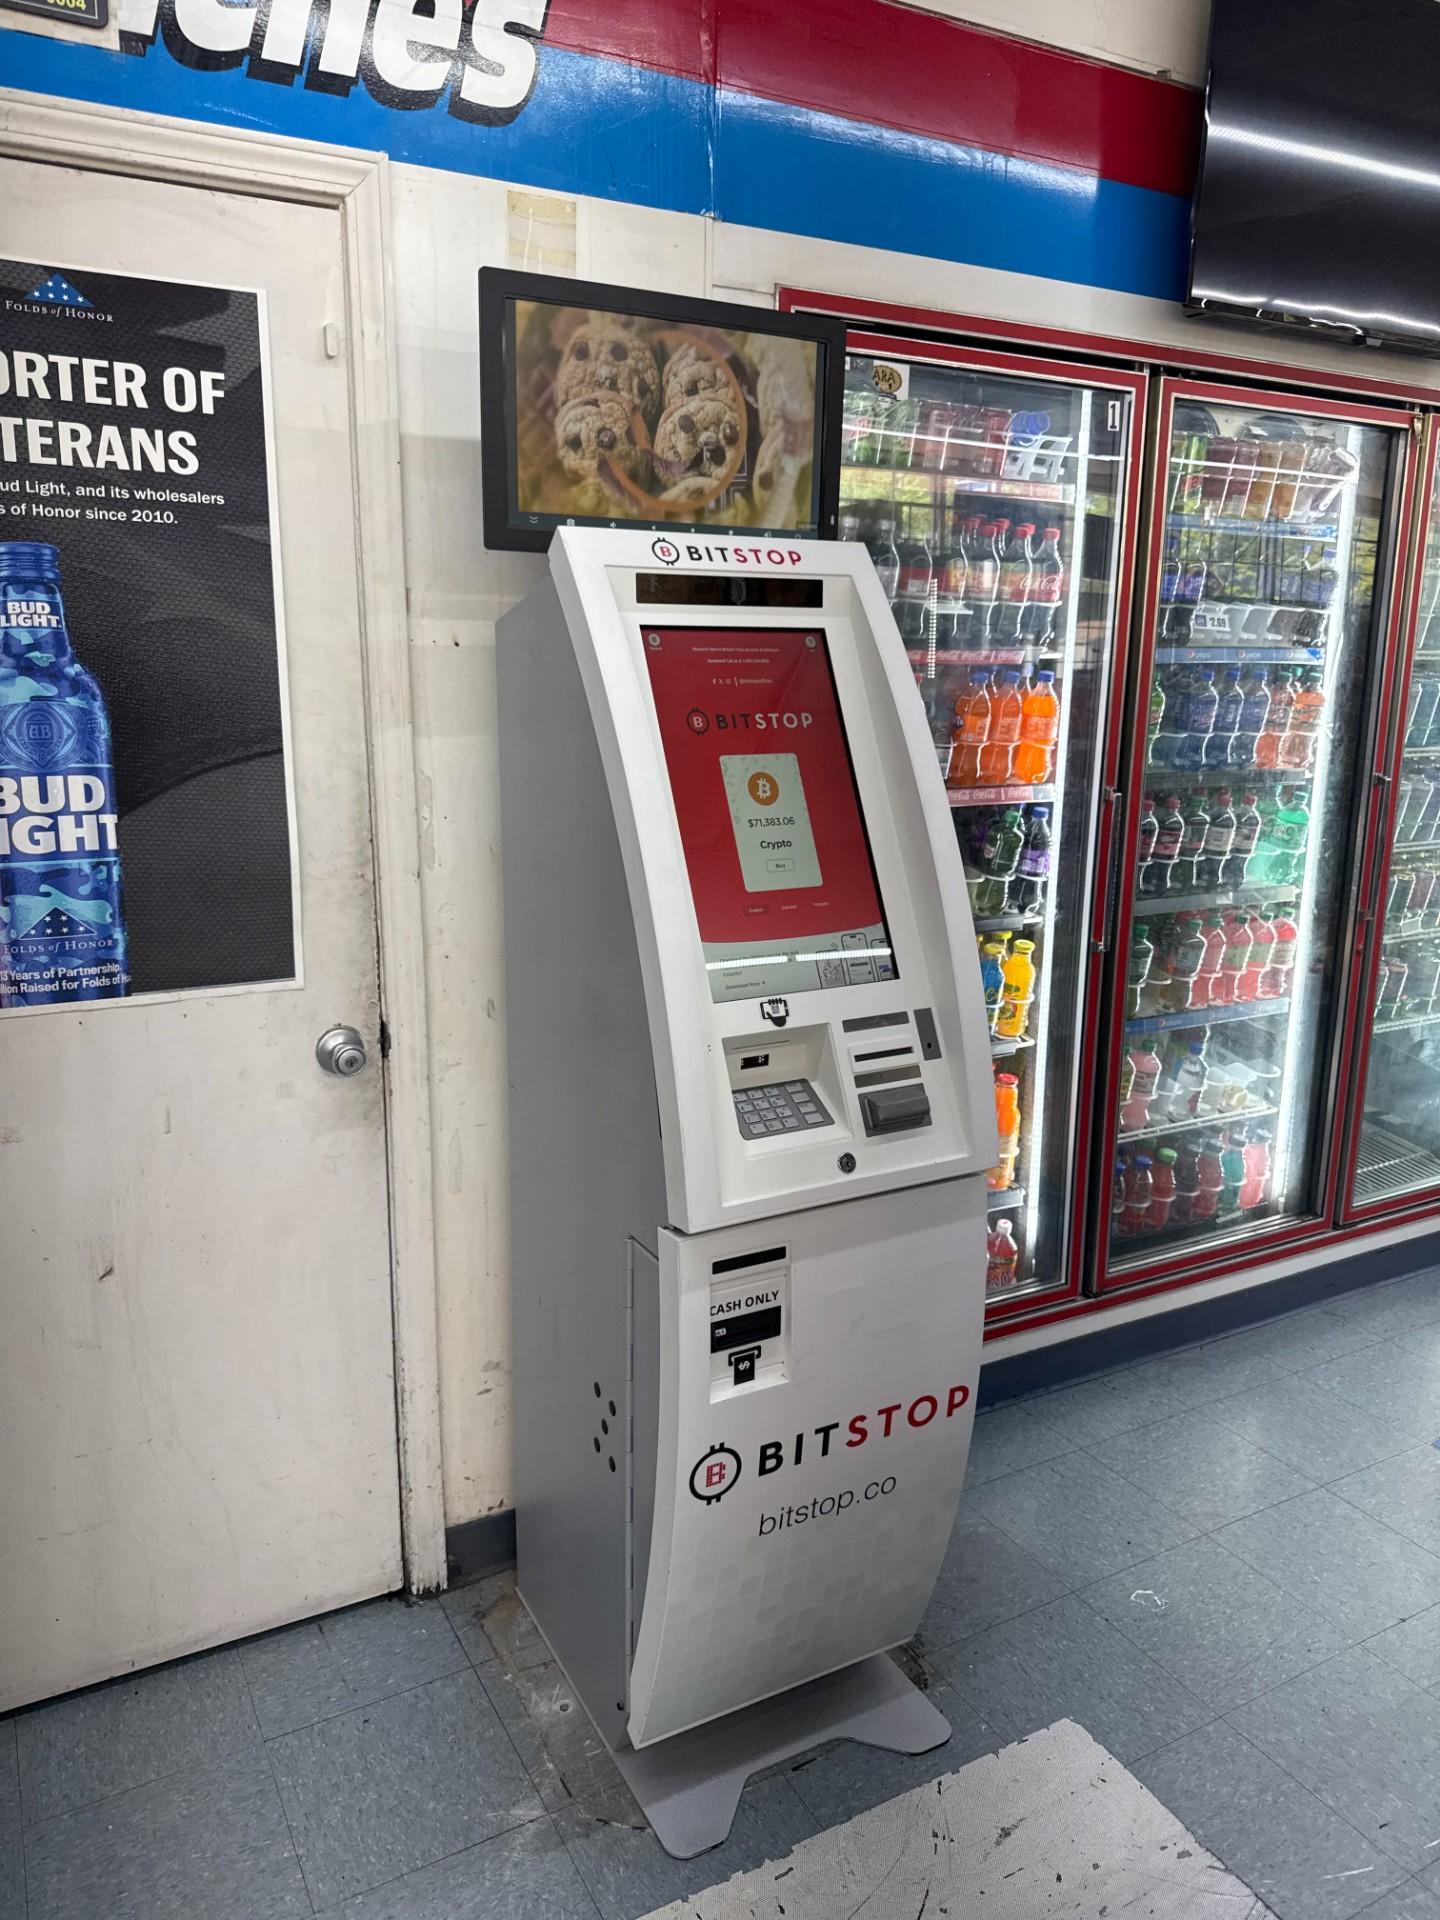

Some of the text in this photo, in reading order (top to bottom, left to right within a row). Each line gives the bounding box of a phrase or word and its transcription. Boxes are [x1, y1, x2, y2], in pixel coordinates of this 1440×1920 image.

[5, 300, 114, 323] FOLDS of HONOR
[162, 366, 226, 415] OF
[0, 416, 200, 476] TERANS
[25, 480, 71, 496] Light,
[75, 485, 106, 498] and
[110, 486, 130, 499] its
[134, 488, 225, 505] wholesalers
[10, 503, 27, 516] of
[32, 504, 81, 519] Honor
[85, 507, 127, 521] since
[131, 509, 178, 525] 2010.
[686, 545, 802, 566] BITSTOP
[7, 601, 51, 615] BUD
[716, 712, 813, 730] BITSTOP
[760, 840, 792, 850] Crypto
[10, 970, 41, 981] Years
[43, 967, 56, 979] of
[20, 980, 60, 993] Raised
[62, 980, 80, 990] for
[82, 975, 111, 988] Folds
[112, 974, 120, 985] of
[710, 1290, 780, 1317] CASH ONLY
[757, 1385, 970, 1477] BITSTOP
[758, 1476, 897, 1537] bitstop.co
